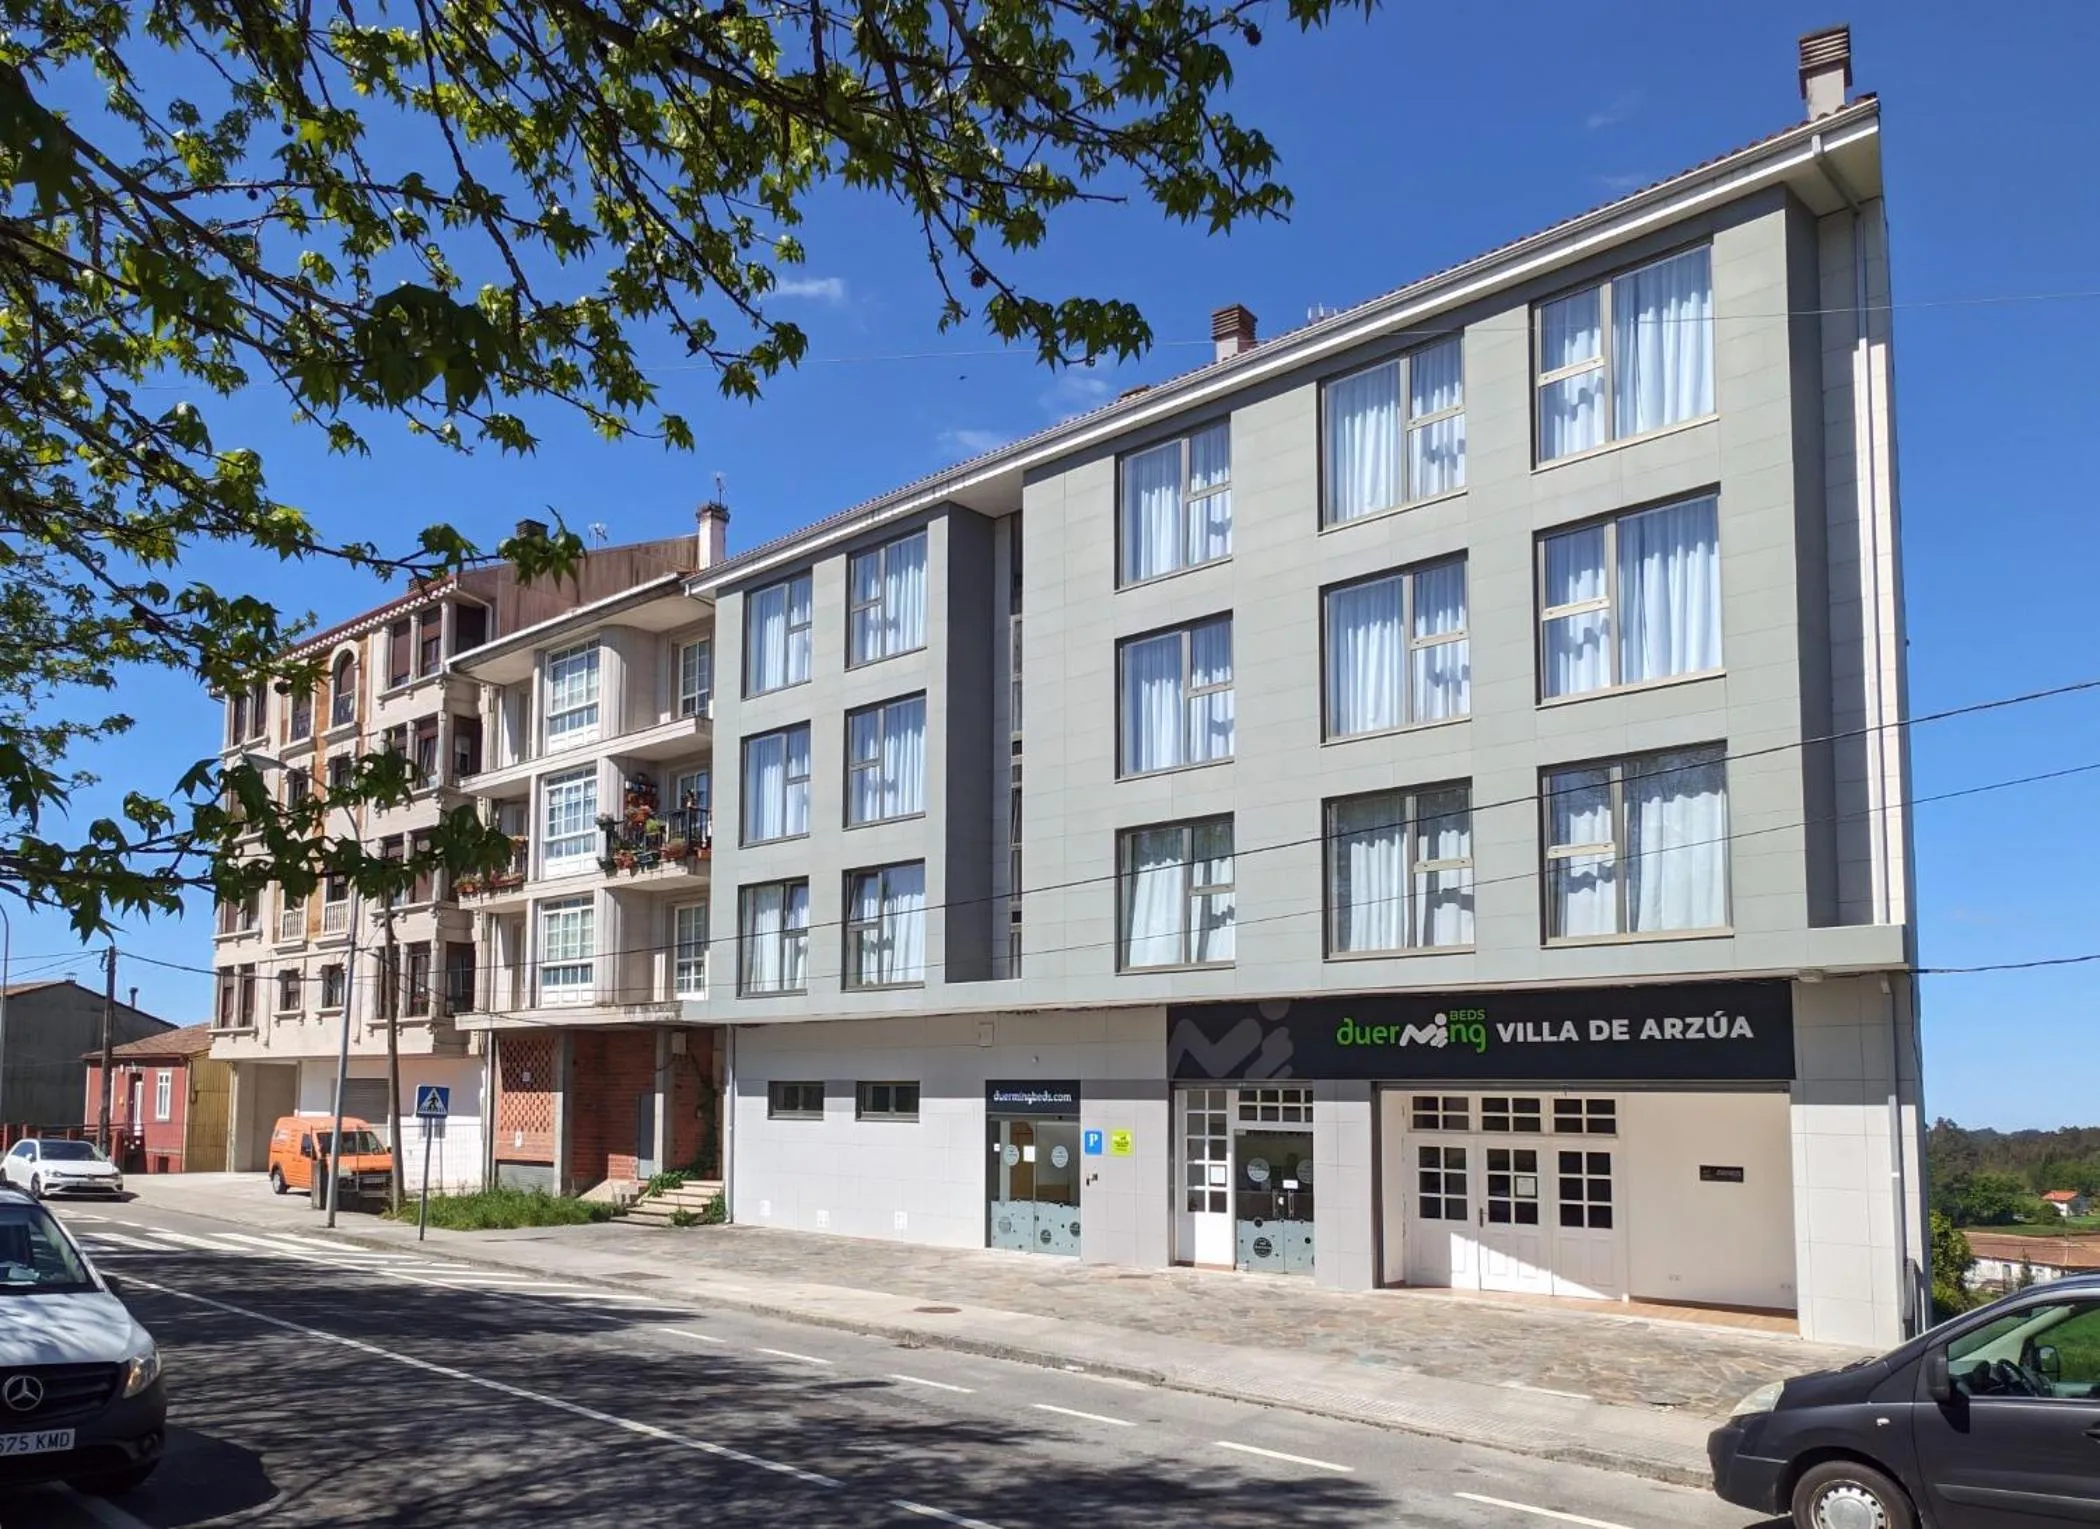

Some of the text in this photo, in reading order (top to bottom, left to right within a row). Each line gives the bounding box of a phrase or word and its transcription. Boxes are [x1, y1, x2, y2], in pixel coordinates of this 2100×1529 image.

[1450, 1009, 1486, 1021] BEDS
[1496, 1020, 1580, 1043] VILLA
[1589, 1019, 1631, 1041] DE
[1640, 1010, 1754, 1040] ARZÚA
[1089, 1133, 1098, 1147] P
[36, 1432, 70, 1449] KMD
